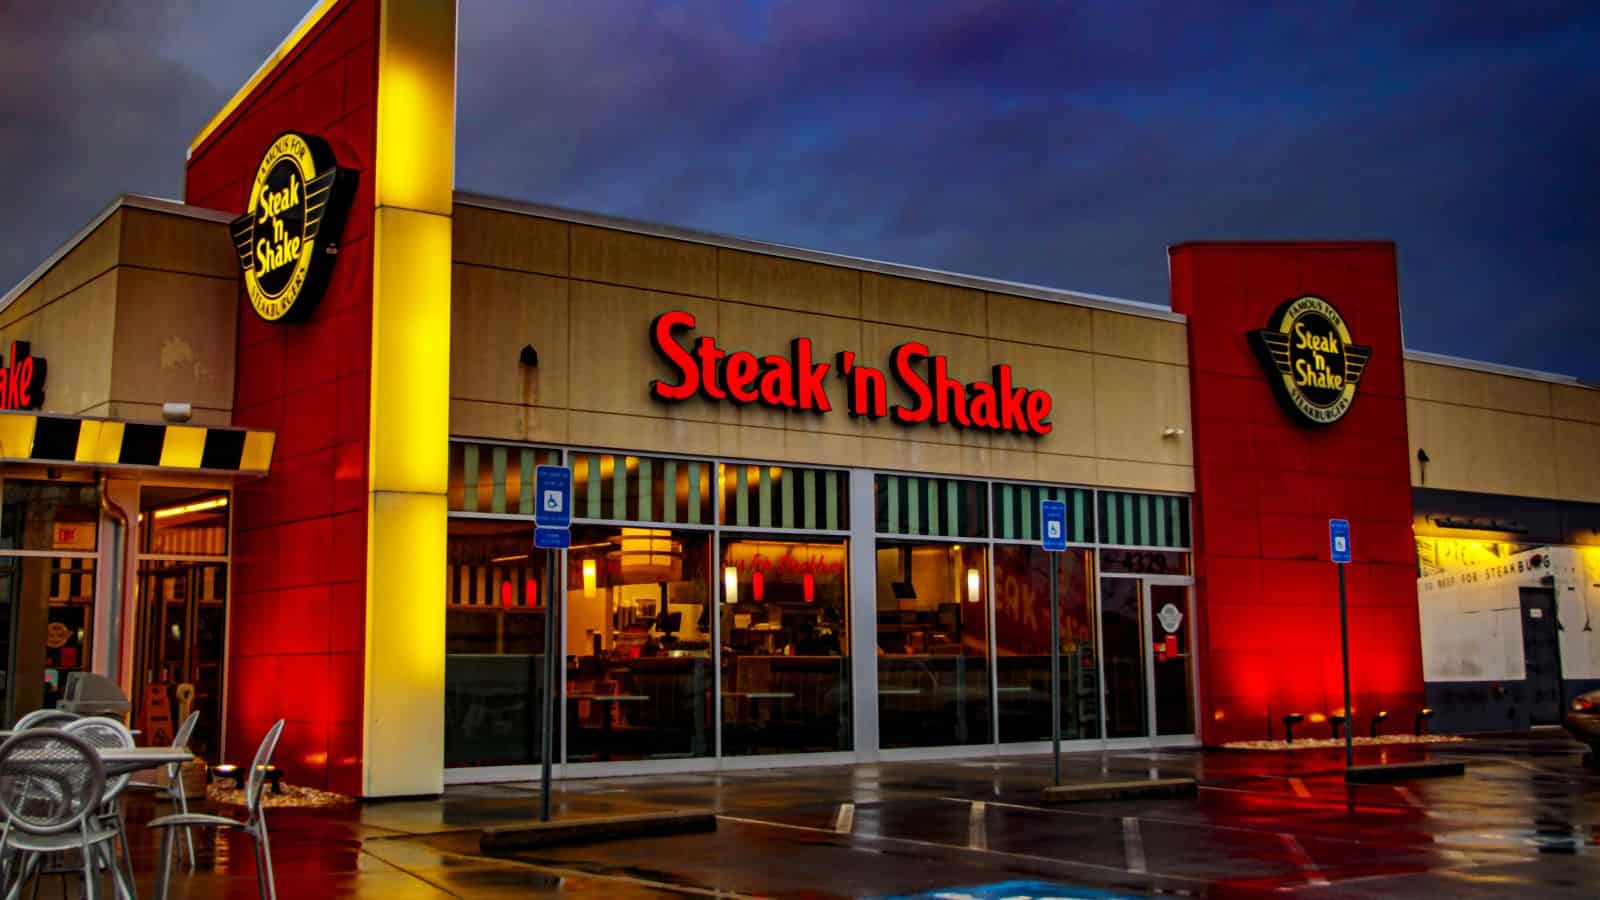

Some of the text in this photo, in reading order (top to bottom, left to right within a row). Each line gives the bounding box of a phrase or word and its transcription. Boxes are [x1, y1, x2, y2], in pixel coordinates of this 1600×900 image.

[258, 174, 299, 224] Steak
[256, 231, 300, 278] Shake
[1295, 322, 1339, 354] Steak
[654, 309, 1053, 435] Steak 'n Shake
[1295, 359, 1345, 390] Shake
[1485, 554, 1551, 580] STEAKBUG
